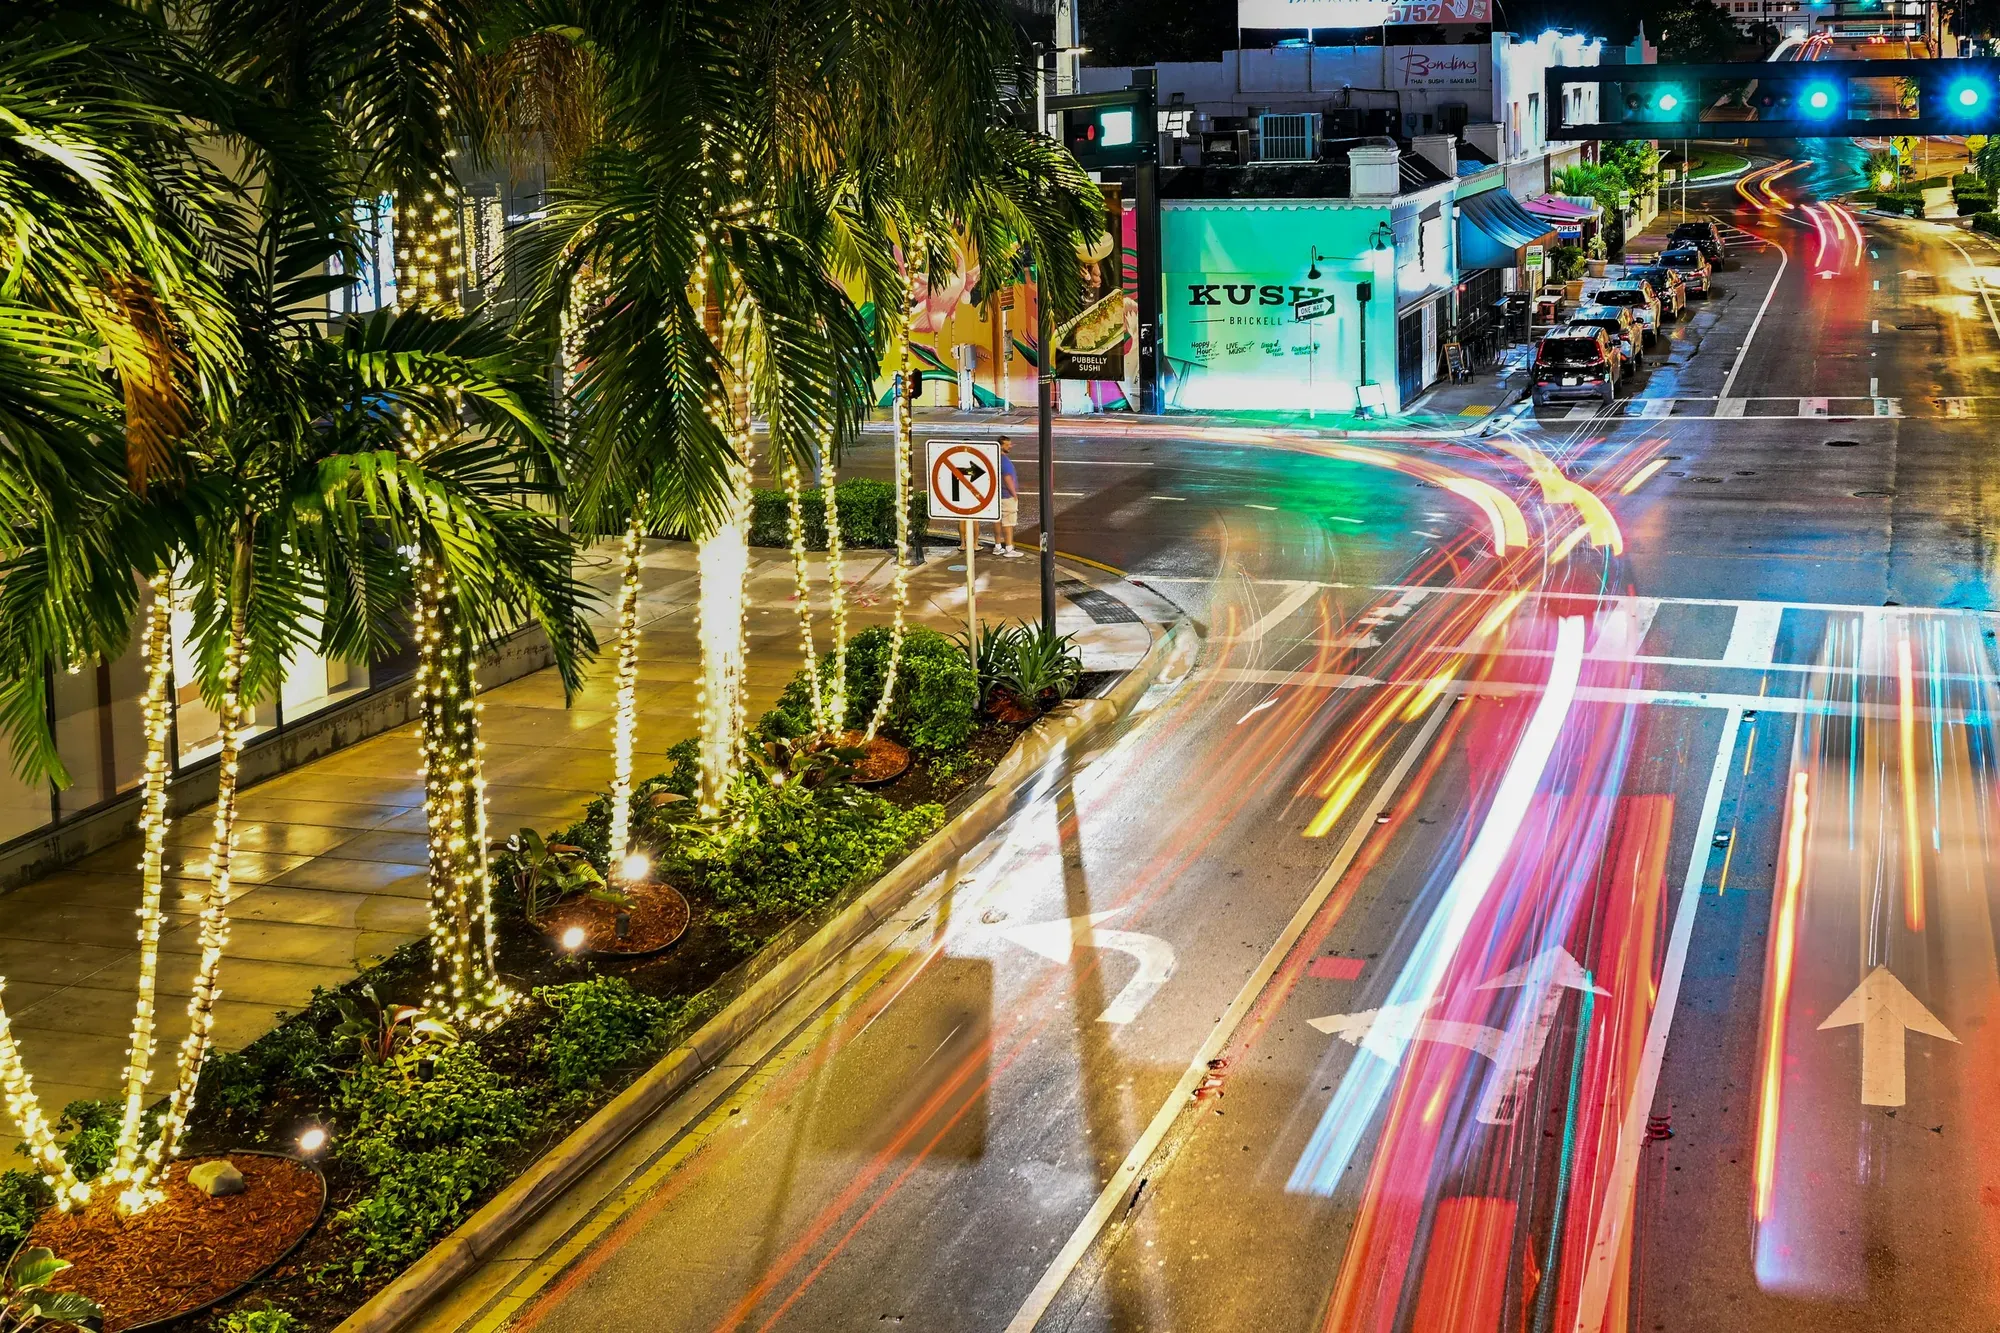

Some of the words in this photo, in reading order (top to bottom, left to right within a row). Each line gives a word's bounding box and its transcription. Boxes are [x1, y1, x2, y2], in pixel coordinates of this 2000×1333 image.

[1388, 4, 1440, 22] 5752
[1398, 47, 1477, 86] Bonding
[1300, 307, 1311, 315] ONE
[1229, 316, 1283, 326] BRICKELL
[1226, 342, 1238, 350] LIVE
[1072, 356, 1107, 364] PUBBELLY
